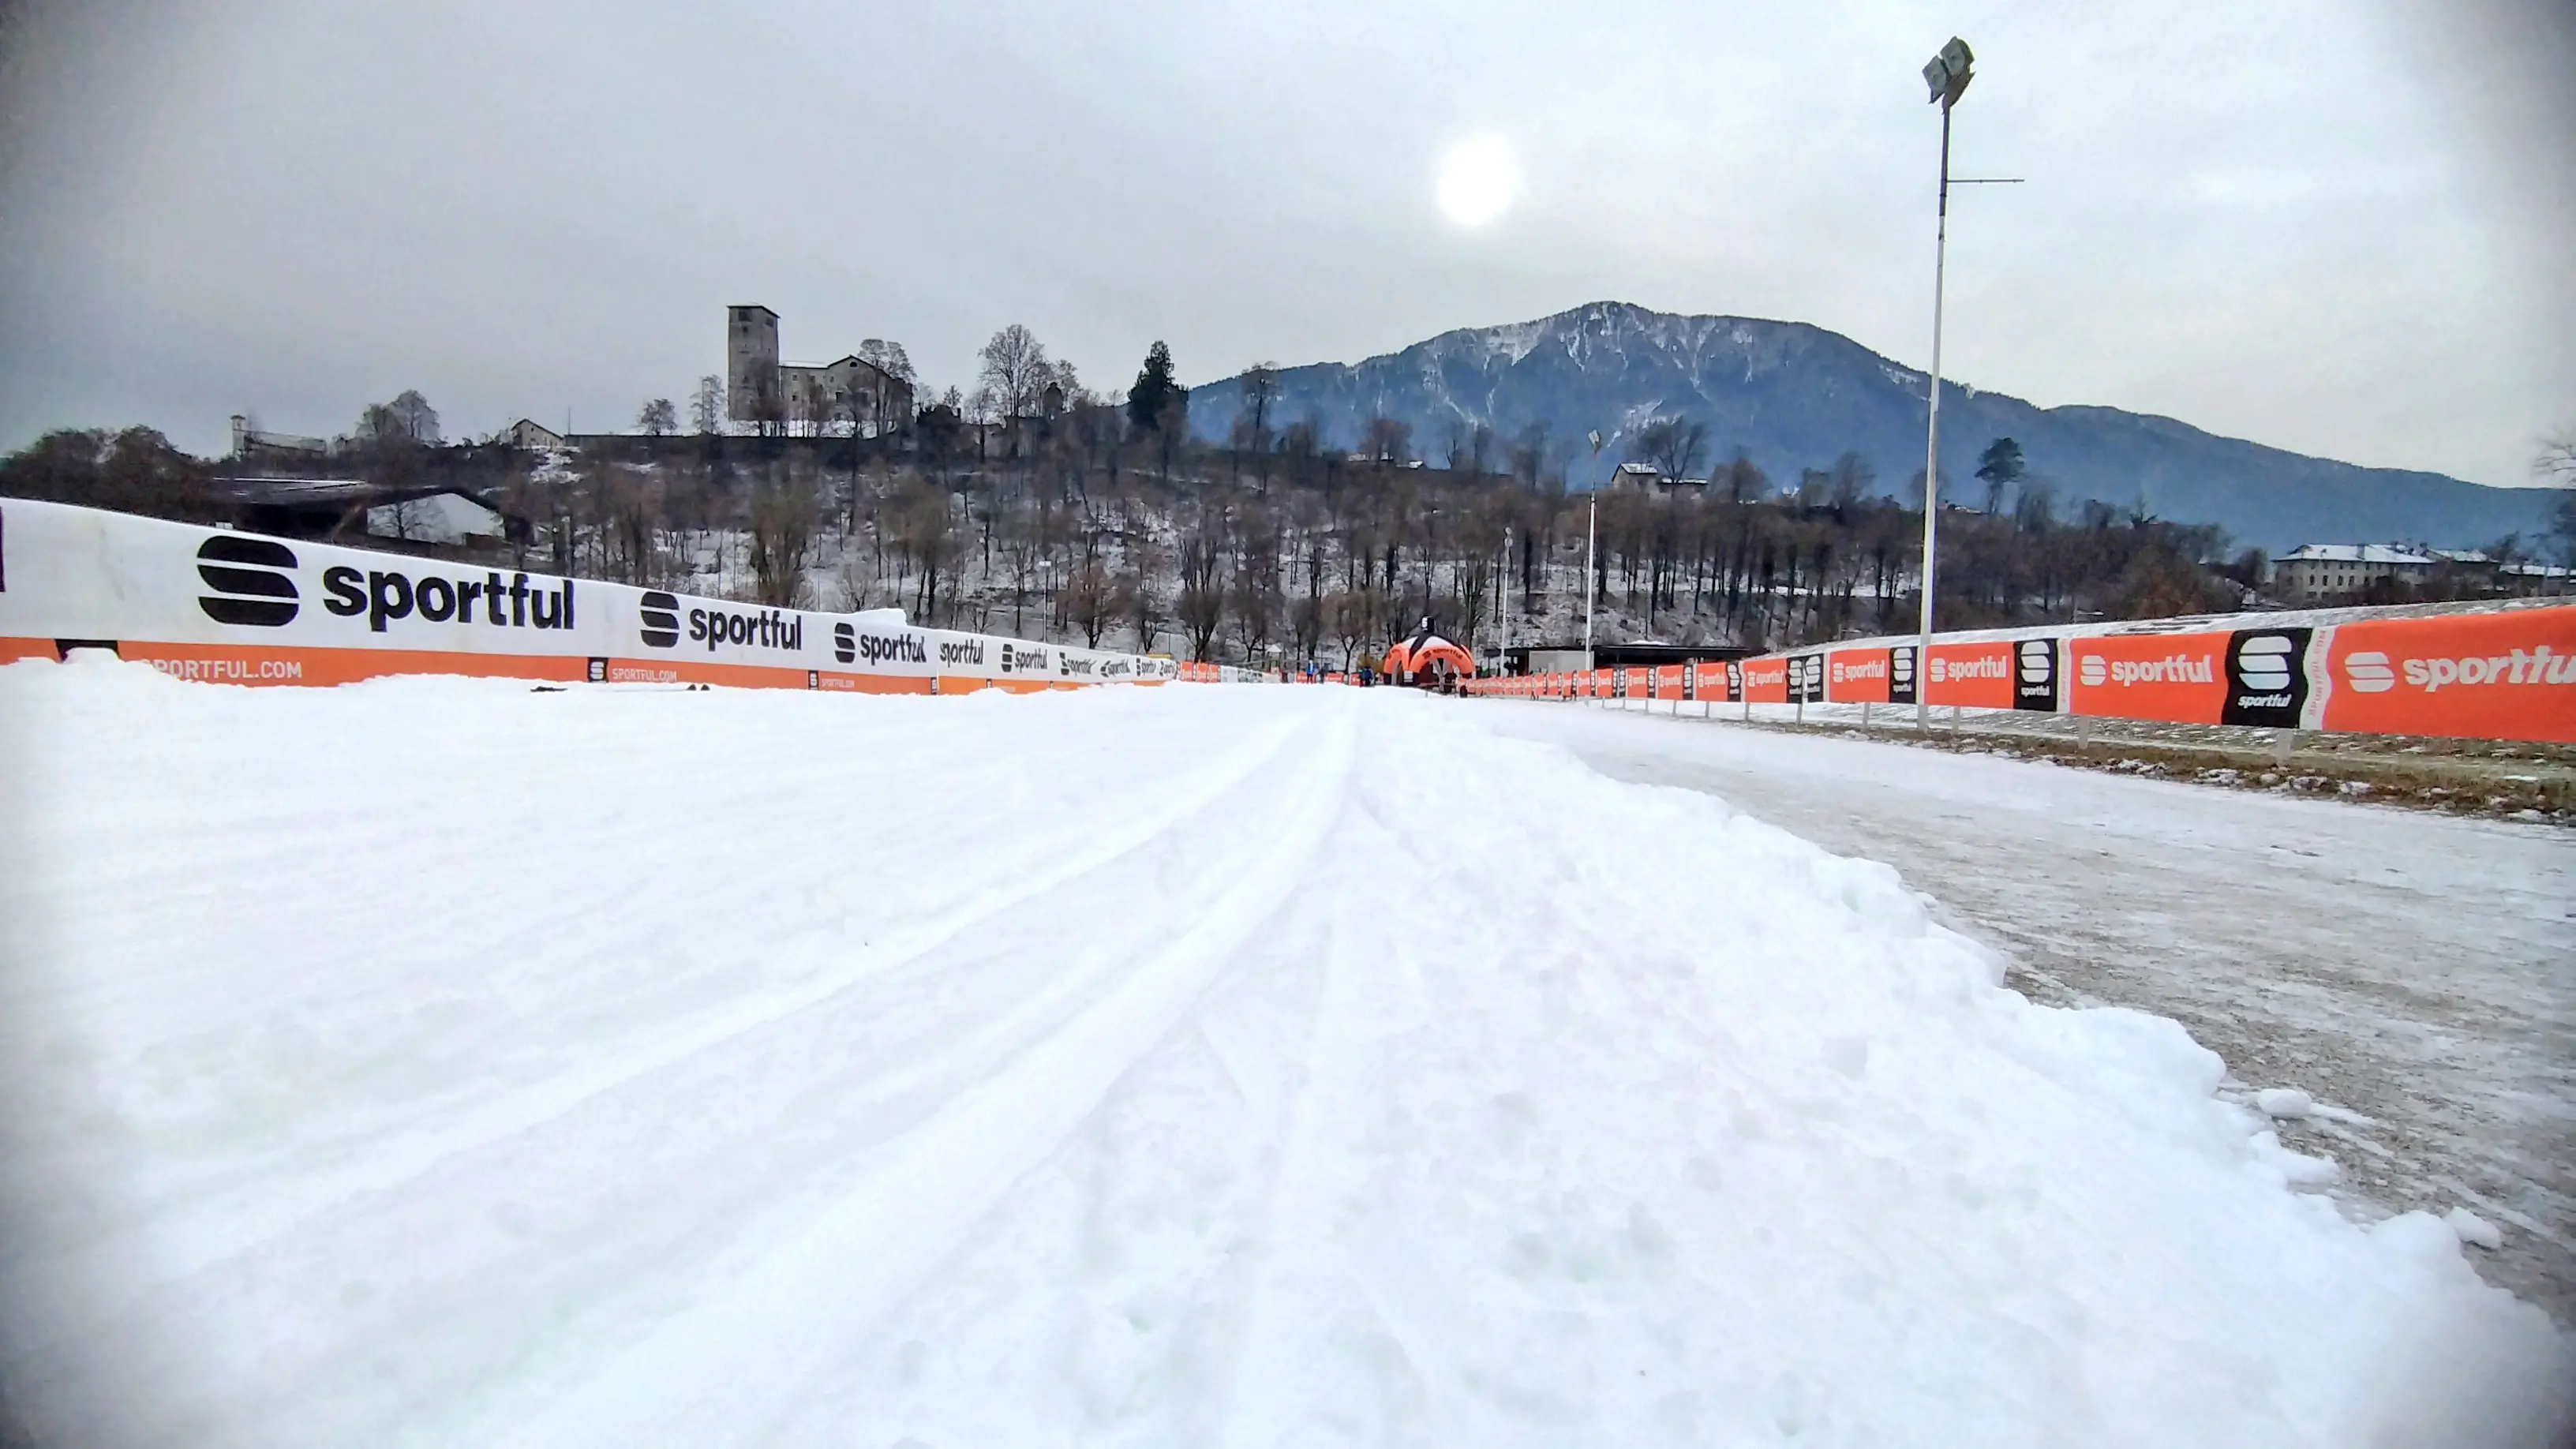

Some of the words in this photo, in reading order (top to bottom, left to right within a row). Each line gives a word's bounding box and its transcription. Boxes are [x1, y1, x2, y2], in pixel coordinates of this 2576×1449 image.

[324, 566, 575, 632] sportful
[689, 608, 802, 652] sportful
[860, 634, 927, 666] sportful
[142, 659, 303, 680] PORTFUL.COM
[1948, 655, 2007, 682] sportful
[2112, 654, 2213, 687] sportful
[2402, 645, 2576, 692] sportfu
[2020, 685, 2050, 698] sportful
[2237, 694, 2292, 709] sportful
